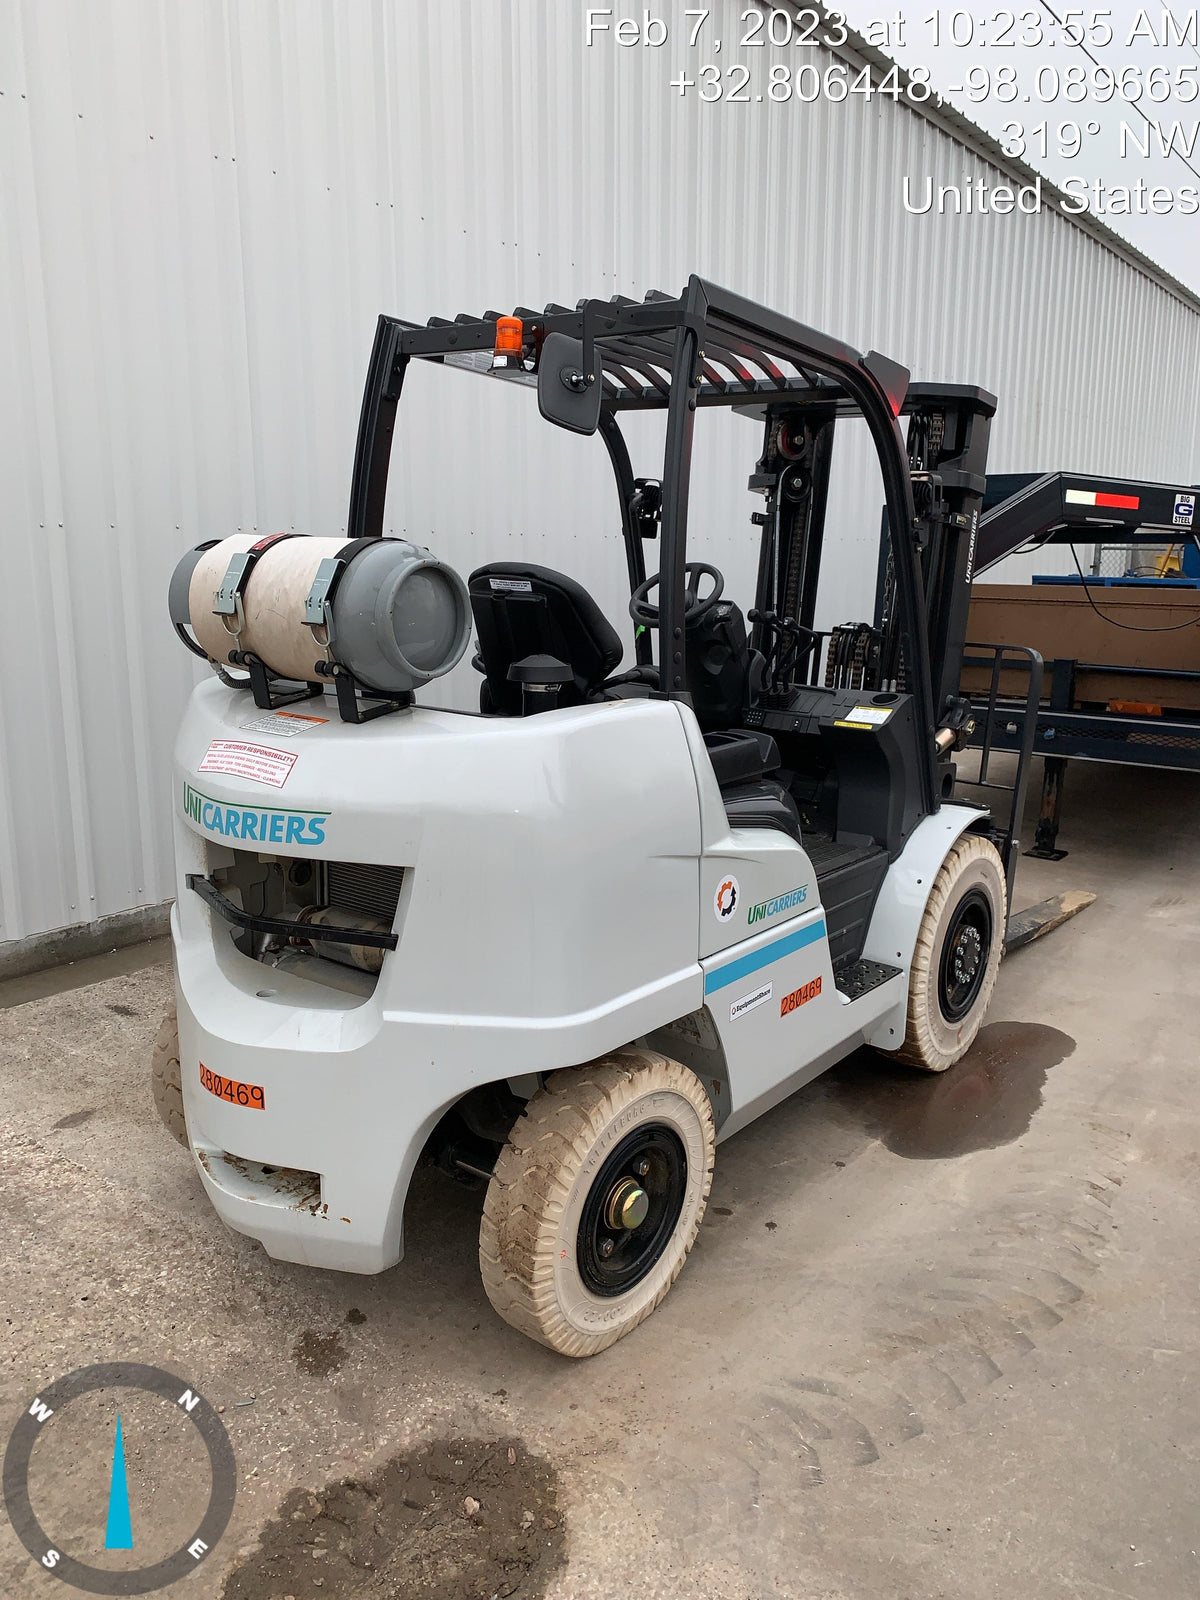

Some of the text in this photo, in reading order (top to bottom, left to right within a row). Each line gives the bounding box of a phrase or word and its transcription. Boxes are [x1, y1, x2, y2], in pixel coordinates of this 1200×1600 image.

[1175, 503, 1193, 516] G
[1180, 495, 1191, 503] BIG
[1174, 516, 1191, 524] STEEL
[964, 508, 979, 585] UNICARRIERS
[223, 743, 247, 751] CUSTOMER
[246, 747, 294, 762] RESPONSIBILITY
[183, 781, 327, 845] UNICARRIERS
[747, 887, 808, 925] UNICARRIERS
[736, 989, 771, 1012] EquipmentShare
[781, 976, 823, 1017] 280469
[199, 1063, 265, 1109] 280469
